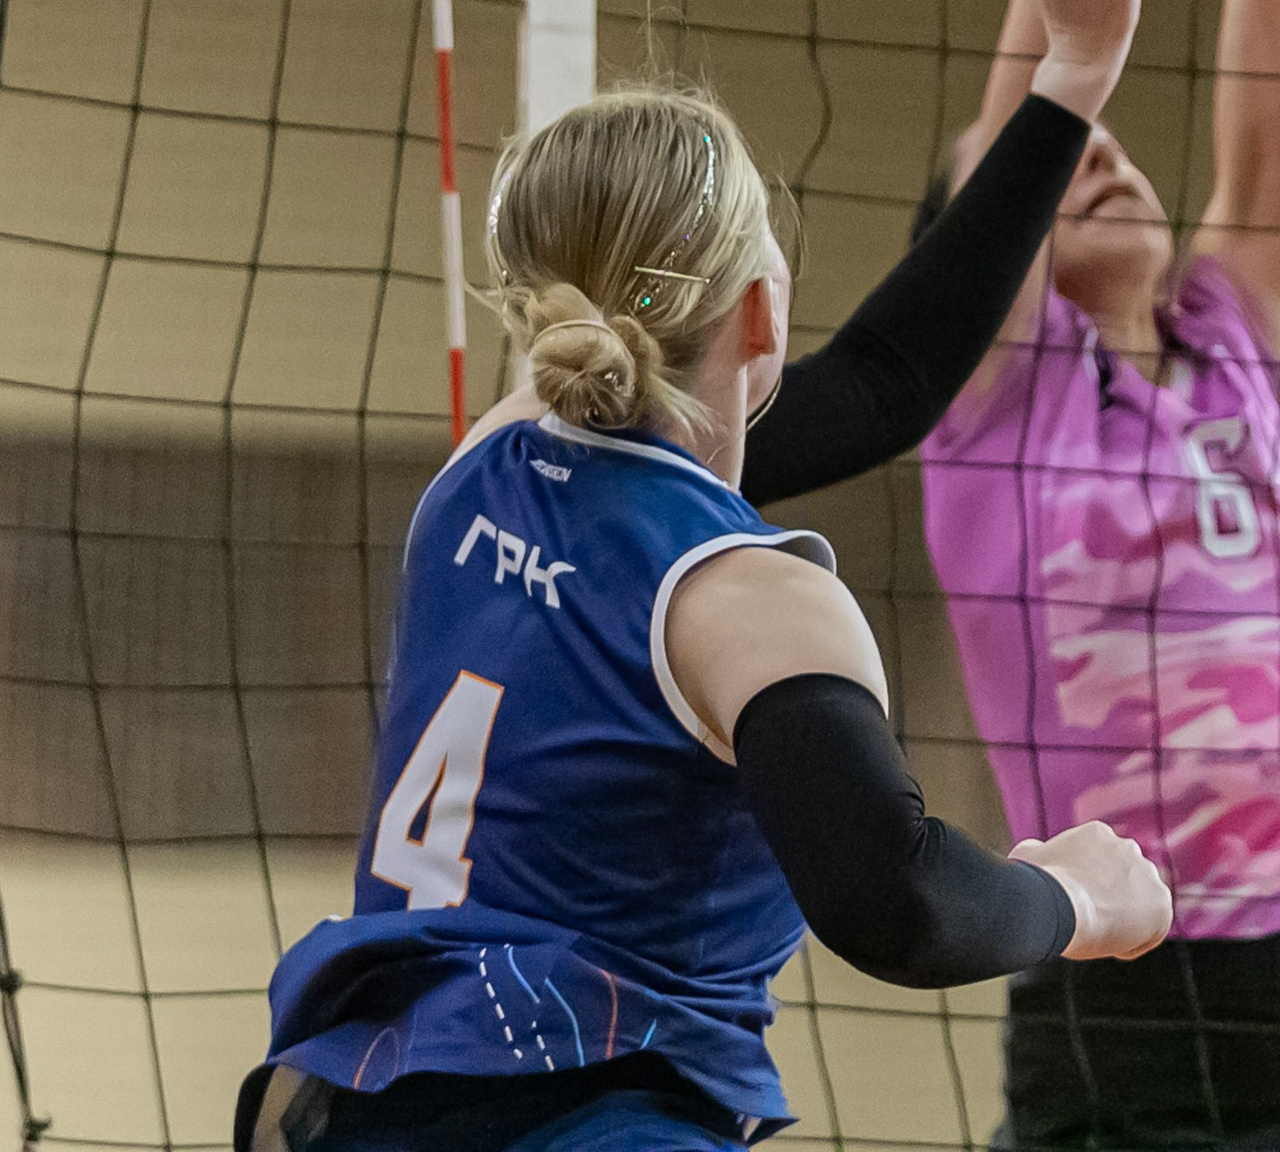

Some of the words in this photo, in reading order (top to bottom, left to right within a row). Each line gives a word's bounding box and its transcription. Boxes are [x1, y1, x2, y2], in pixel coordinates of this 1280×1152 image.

[1187, 416, 1260, 559] 6
[453, 513, 577, 610] ГРК
[371, 669, 505, 911] 4
